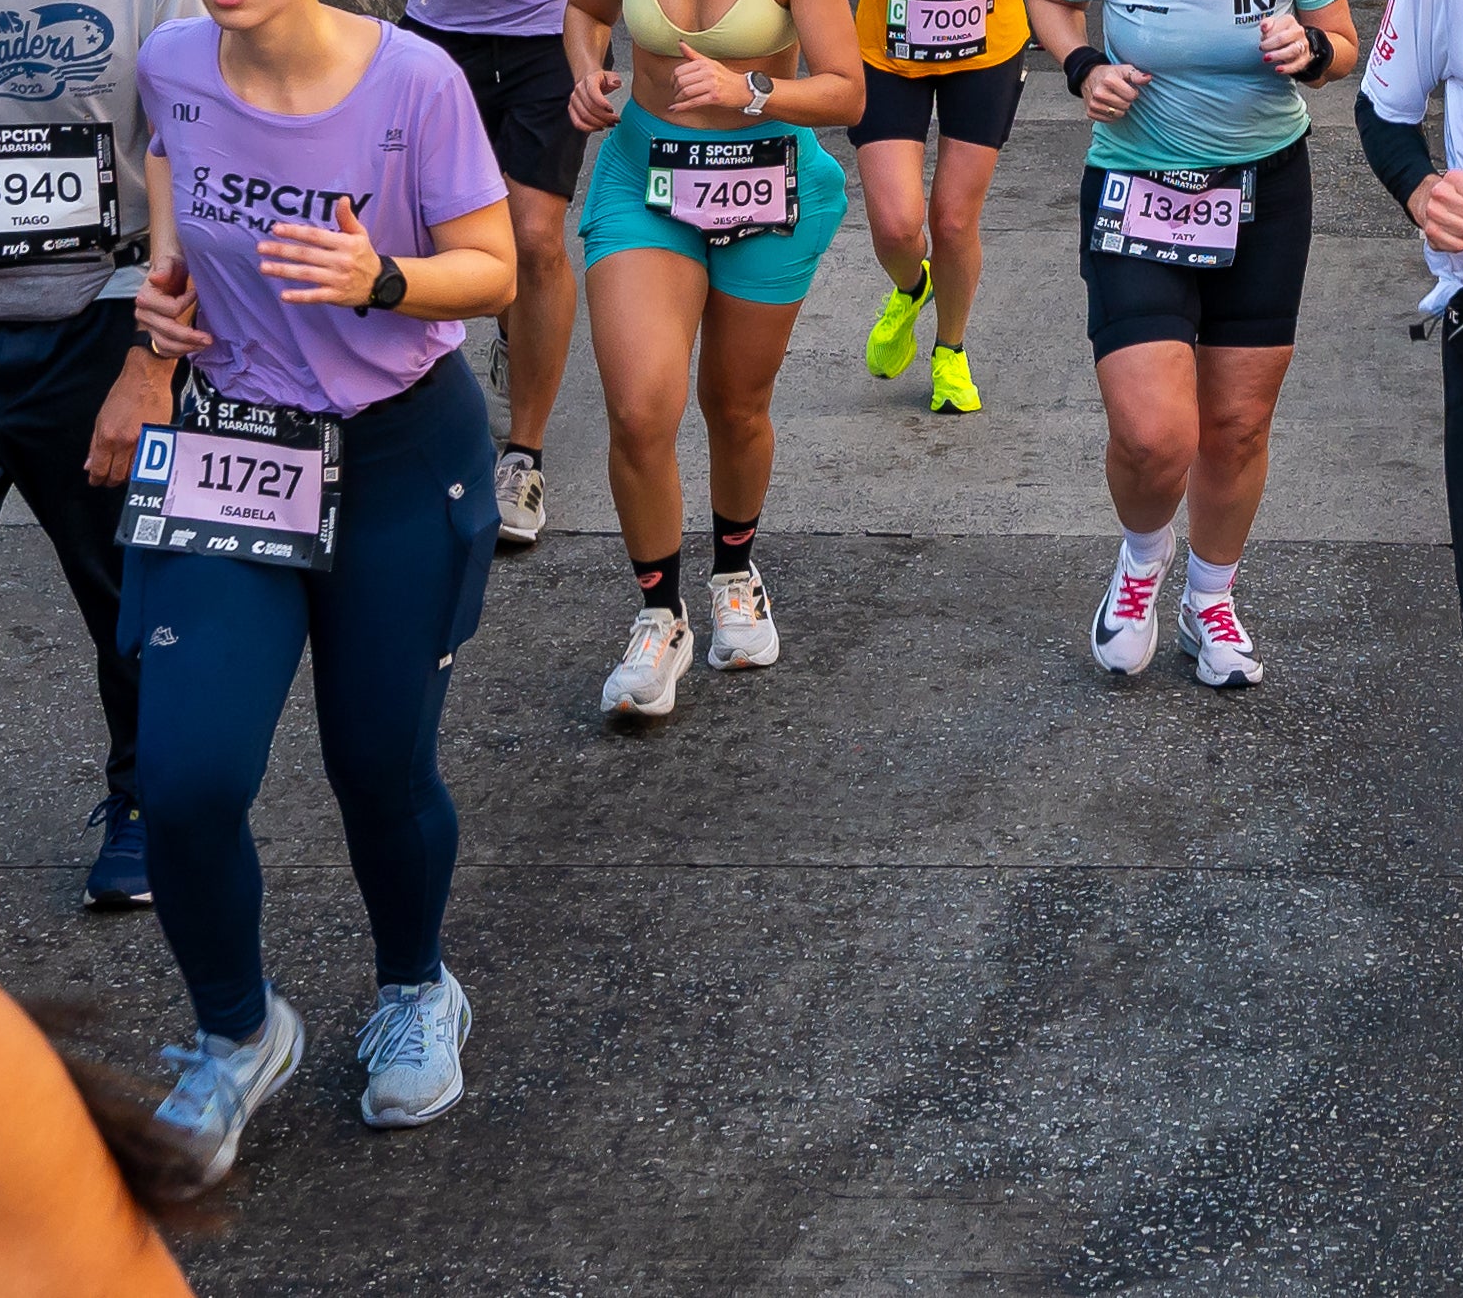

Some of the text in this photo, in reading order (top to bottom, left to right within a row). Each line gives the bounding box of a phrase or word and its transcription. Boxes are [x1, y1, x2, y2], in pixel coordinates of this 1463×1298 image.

[894, 3, 903, 20] C
[921, 6, 981, 29] 7000
[932, 33, 972, 42] FERNANDA
[10, 83, 45, 95] 2022
[706, 144, 754, 156] SPCITY
[705, 156, 754, 165] MARATHON
[654, 176, 667, 197] C
[1108, 181, 1125, 202] D
[1163, 176, 1208, 190] MARATHON
[218, 173, 373, 221] SPCITY
[694, 179, 772, 208] 7409
[191, 201, 241, 224] HALF
[1139, 192, 1232, 227] 13493
[11, 215, 50, 226] TIAGO
[713, 216, 754, 225] JESSICA
[1172, 233, 1196, 242] TATY
[218, 419, 277, 437] MARATHON
[145, 440, 168, 470] D
[198, 452, 303, 501] 11727
[128, 494, 163, 509] 21.1K
[220, 505, 276, 522] ISABELA
